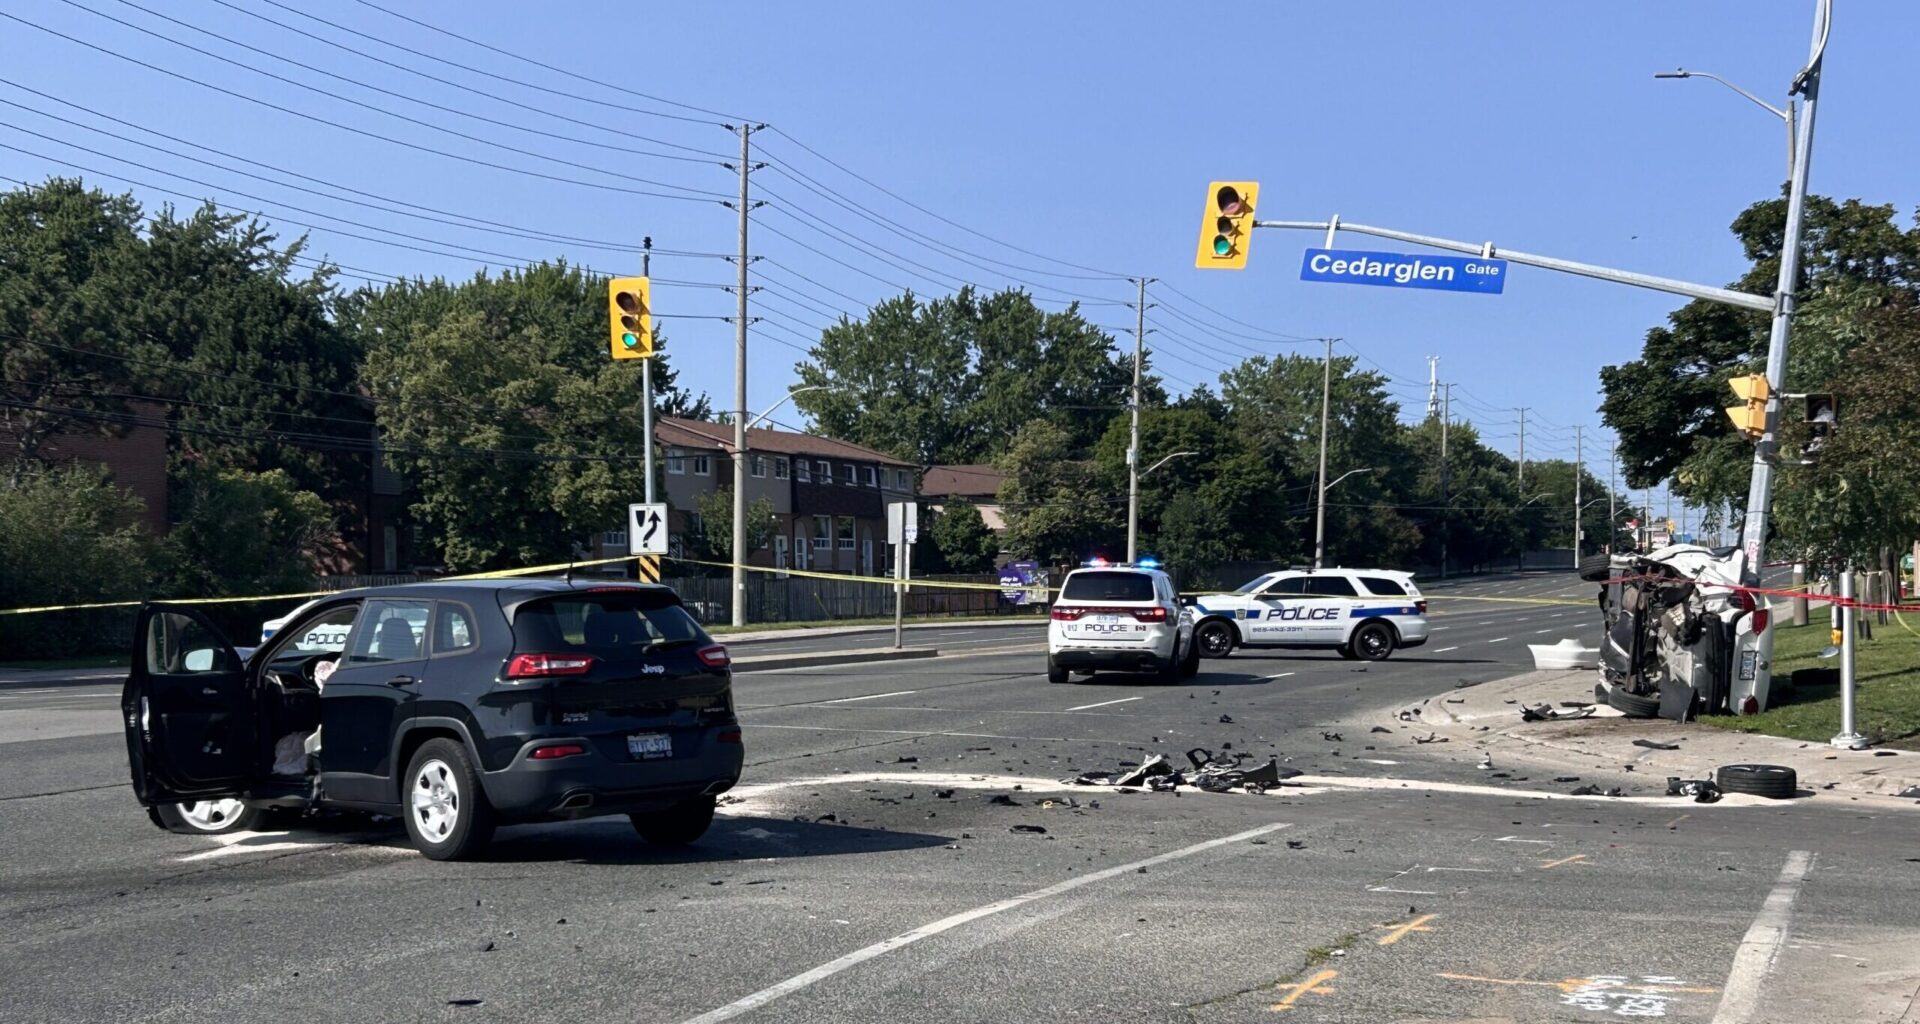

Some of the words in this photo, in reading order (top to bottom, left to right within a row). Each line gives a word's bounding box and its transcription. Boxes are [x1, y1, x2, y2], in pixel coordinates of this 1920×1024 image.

[1310, 254, 1455, 283] Cedarglen
[1464, 263, 1499, 275] Gate
[1266, 607, 1340, 621] POLICE
[1085, 624, 1127, 632] POLICE
[307, 633, 347, 645] POLIC
[641, 664, 664, 674] Jeep
